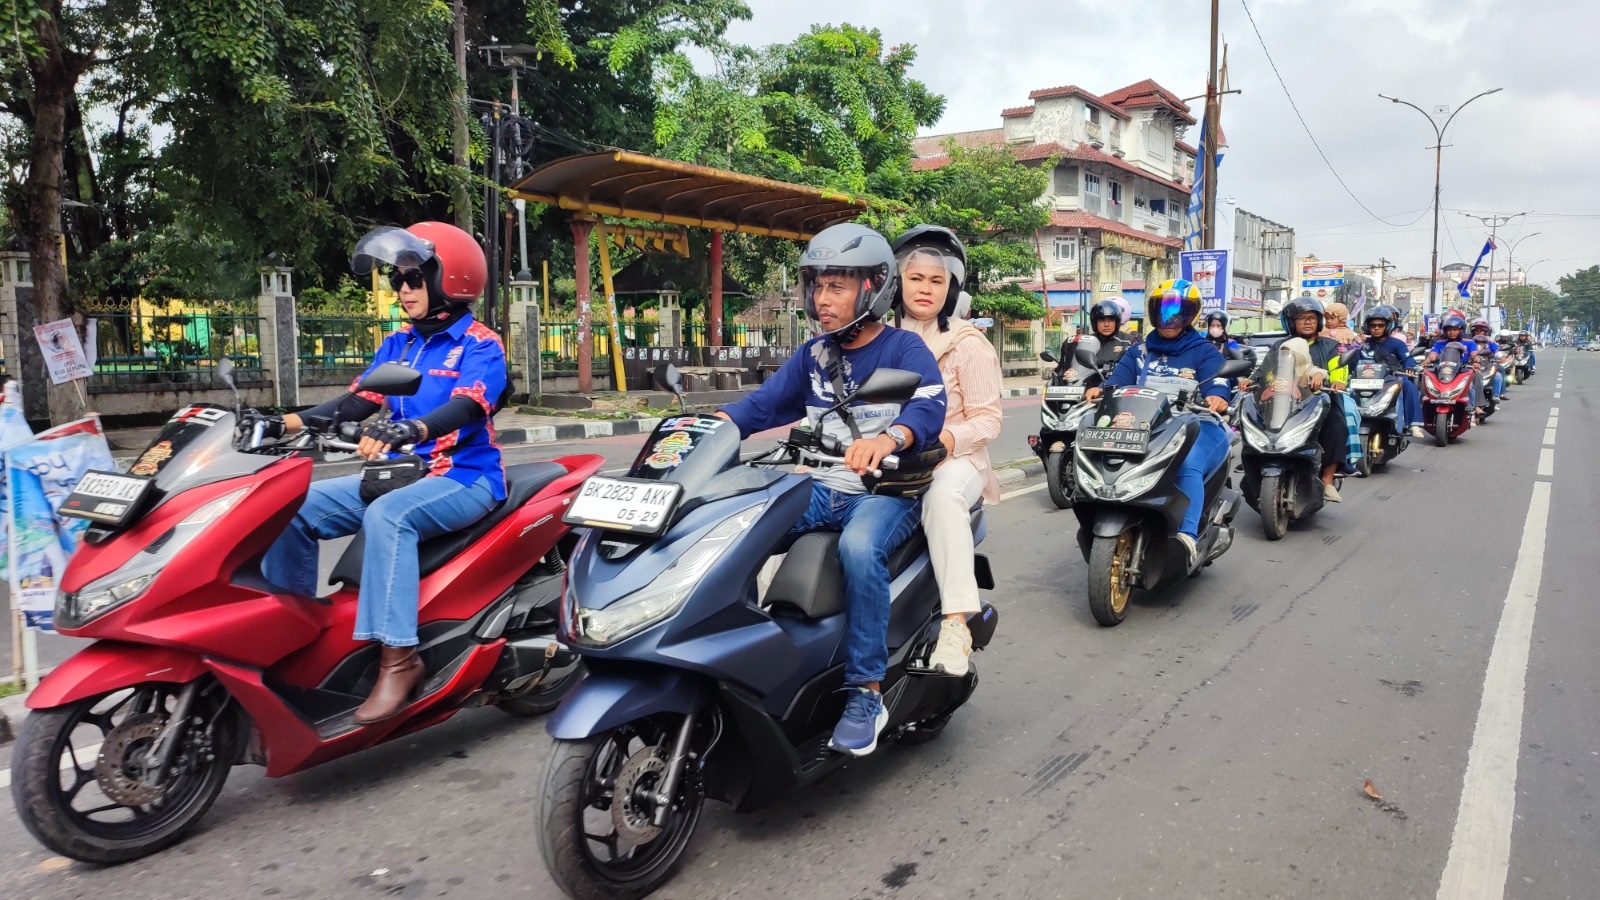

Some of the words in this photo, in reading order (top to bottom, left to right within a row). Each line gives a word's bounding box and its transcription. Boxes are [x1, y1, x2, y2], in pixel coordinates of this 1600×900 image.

[864, 408, 895, 419] NUSANTARA
[1086, 430, 1122, 440] BK2940
[640, 488, 672, 505] AKK
